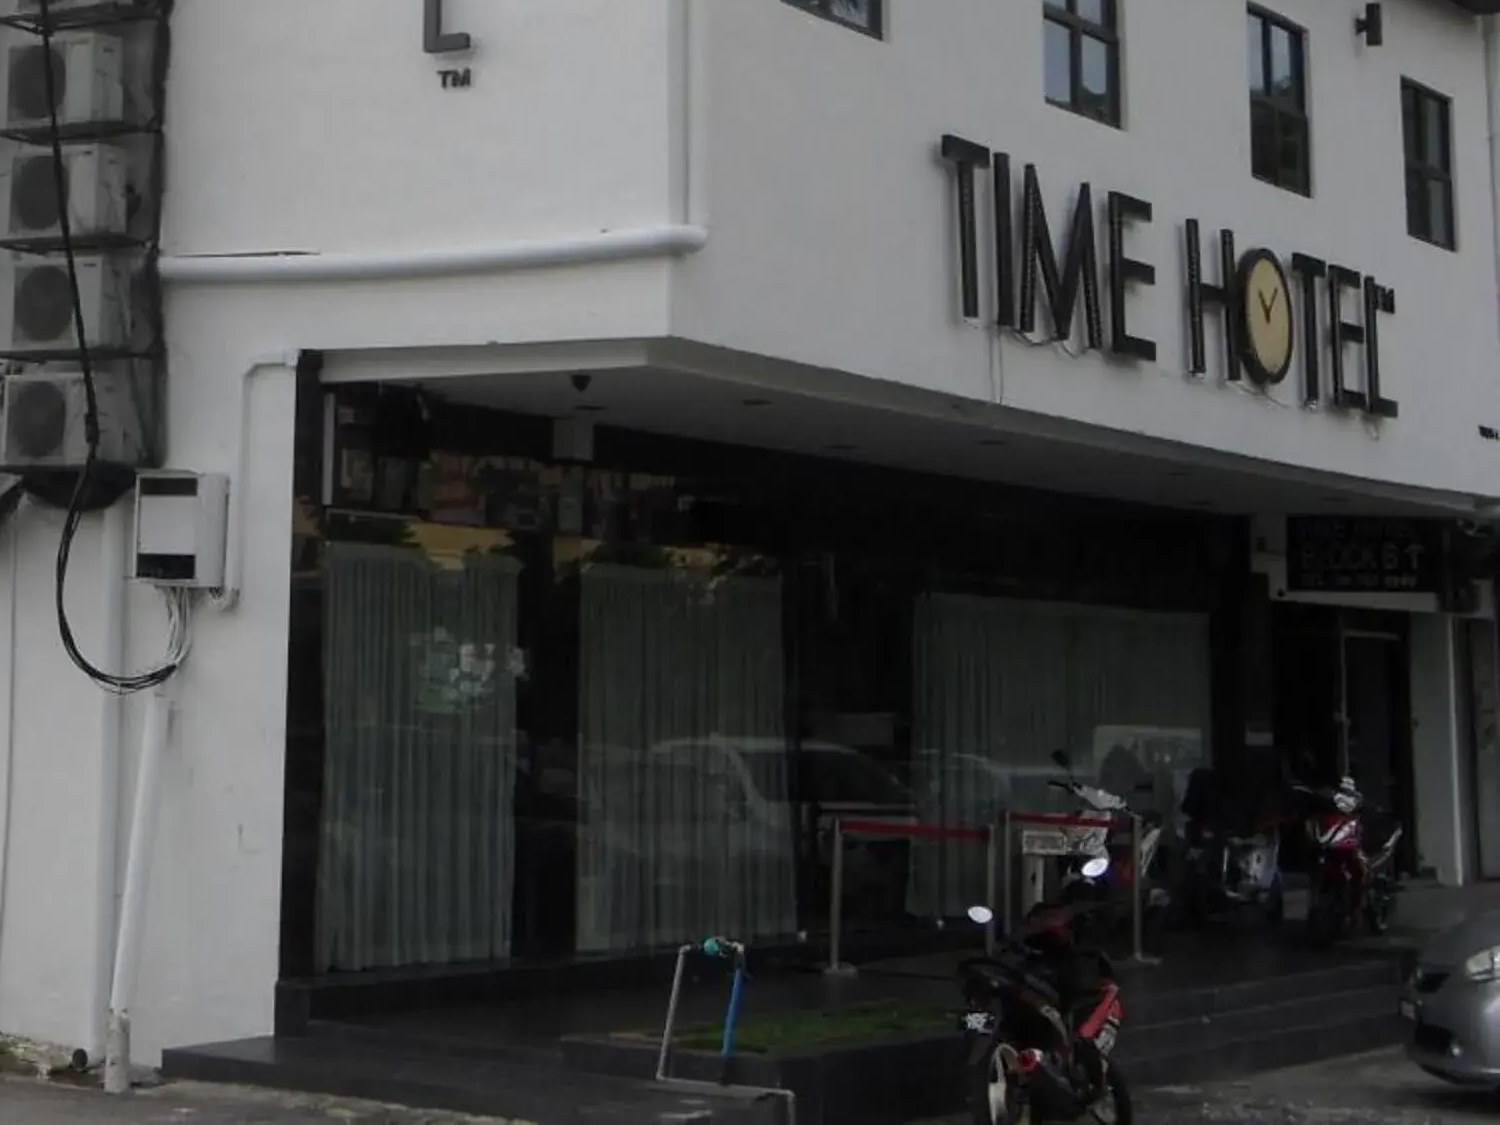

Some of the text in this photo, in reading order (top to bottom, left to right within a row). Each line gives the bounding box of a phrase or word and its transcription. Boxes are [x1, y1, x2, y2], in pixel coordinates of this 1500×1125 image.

[436, 67, 471, 89] TM
[941, 133, 1157, 362] TIME
[1185, 217, 1398, 418] HOTEL
